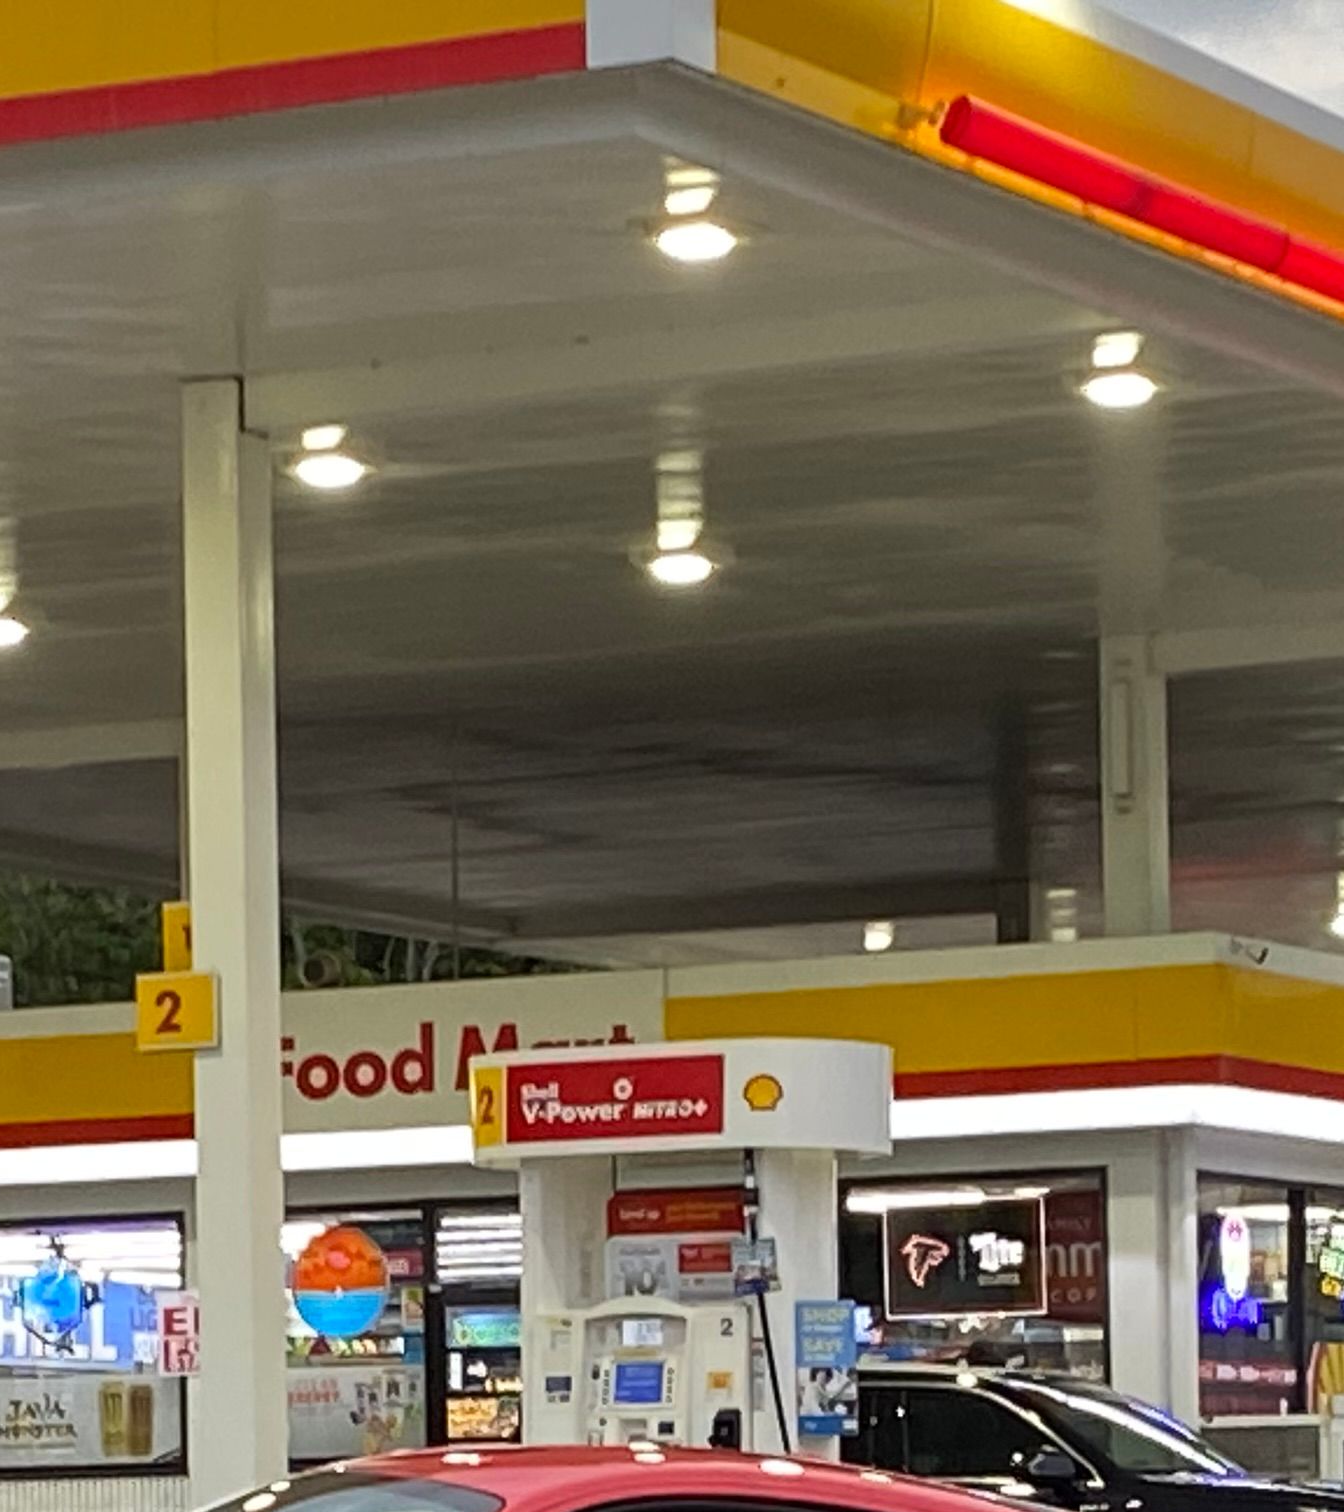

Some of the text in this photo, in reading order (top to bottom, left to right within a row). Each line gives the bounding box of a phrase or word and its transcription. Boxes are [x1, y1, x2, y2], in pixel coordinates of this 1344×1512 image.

[155, 989, 183, 1034] 2
[480, 1086, 494, 1124] 2
[521, 1102, 623, 1125] V-Power
[720, 1318, 734, 1336] 2
